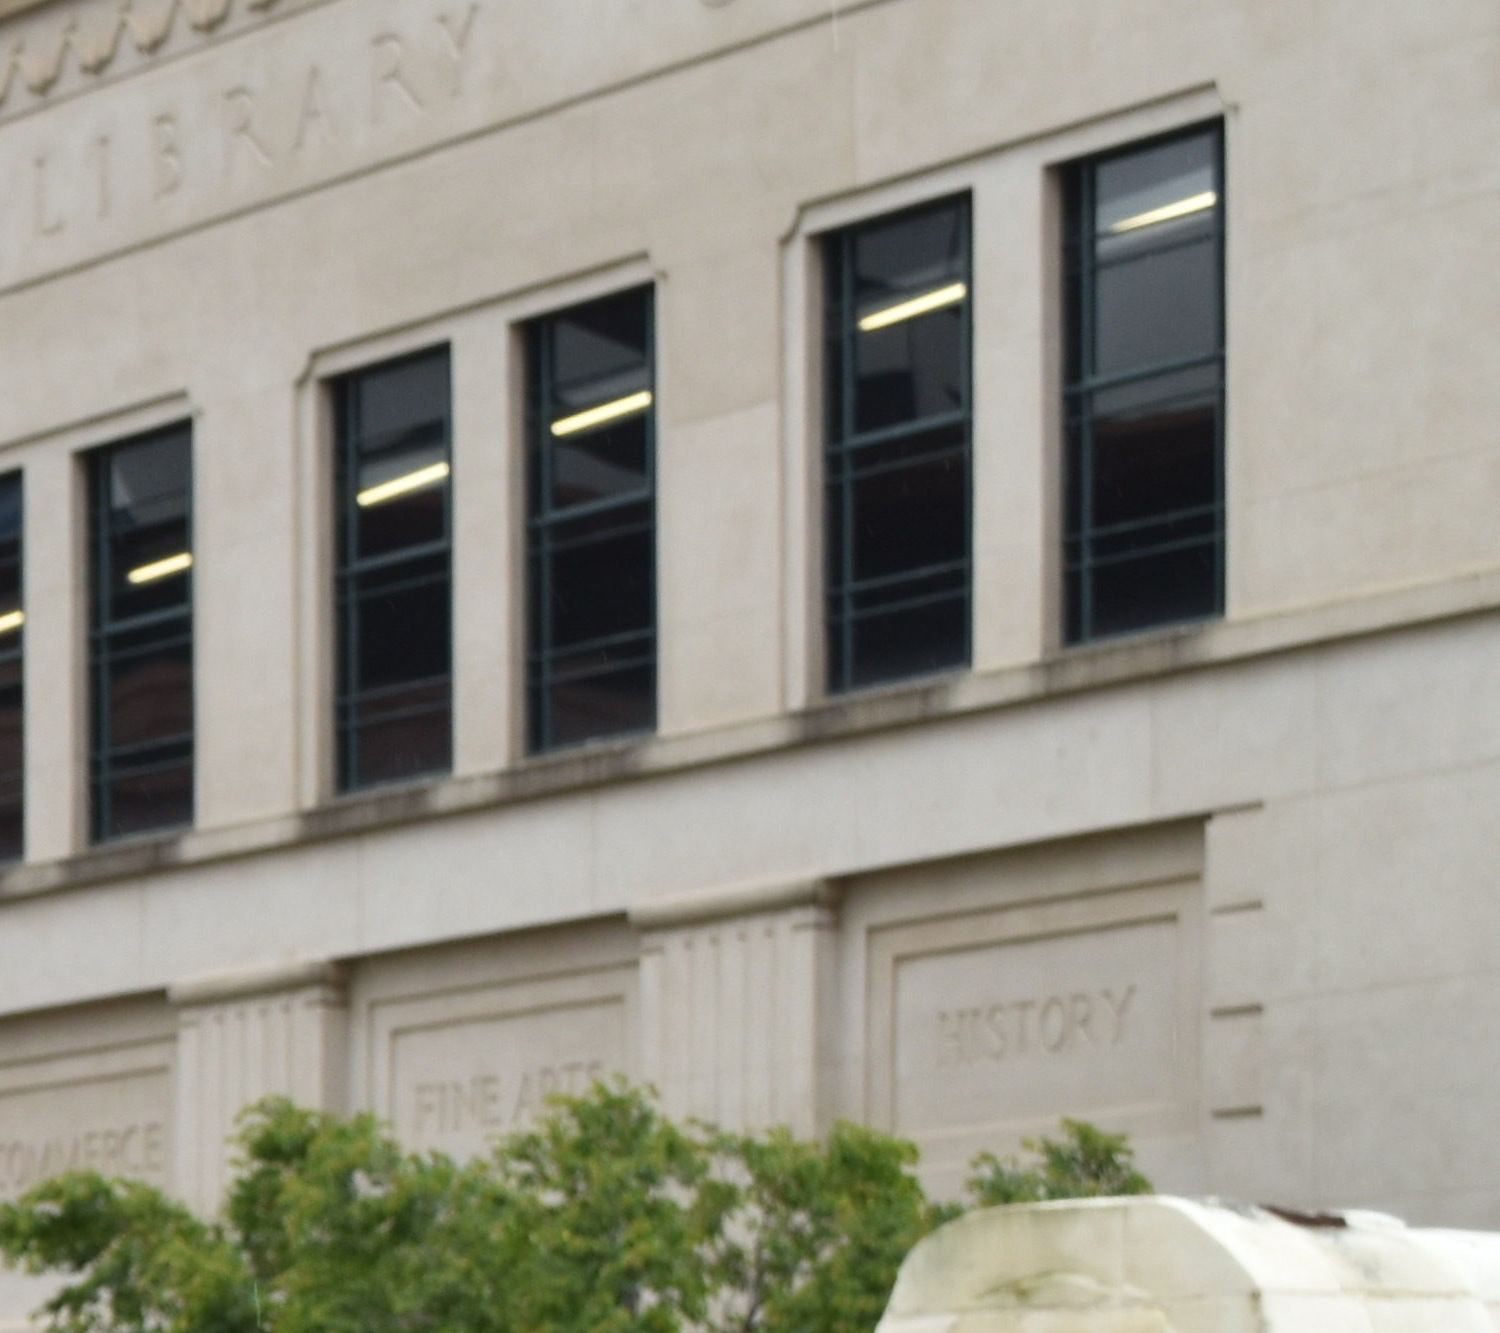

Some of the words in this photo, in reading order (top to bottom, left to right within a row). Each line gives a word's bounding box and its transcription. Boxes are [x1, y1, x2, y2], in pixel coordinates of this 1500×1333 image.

[33, 2, 480, 237] LIBRARY
[936, 983, 1138, 1068] HISTORY
[412, 1073, 502, 1135] FINE
